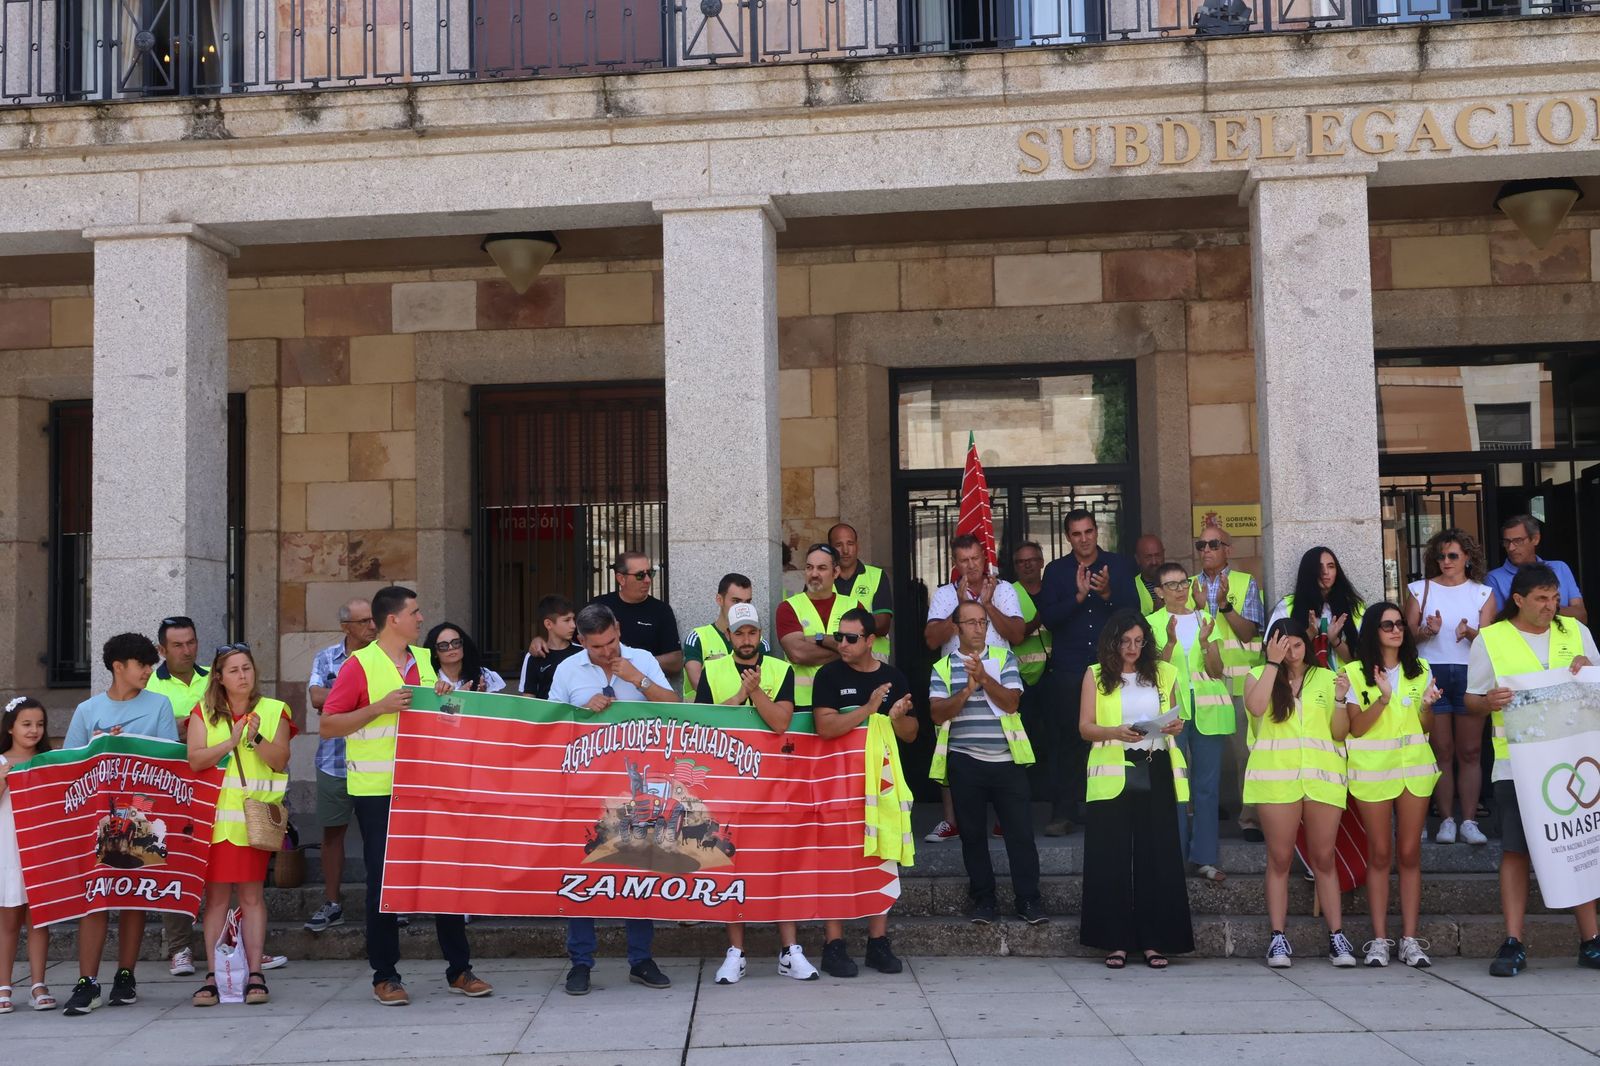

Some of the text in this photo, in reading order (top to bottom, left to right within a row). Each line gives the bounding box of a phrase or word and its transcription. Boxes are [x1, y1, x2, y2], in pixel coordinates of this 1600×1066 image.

[1018, 95, 1600, 176] SUBDELEGACIO
[561, 717, 762, 779] AGRICULTORES Y GANADEROS
[64, 757, 194, 815] AGRICUORES Y GANADEROS
[557, 874, 746, 906] ZAMORA
